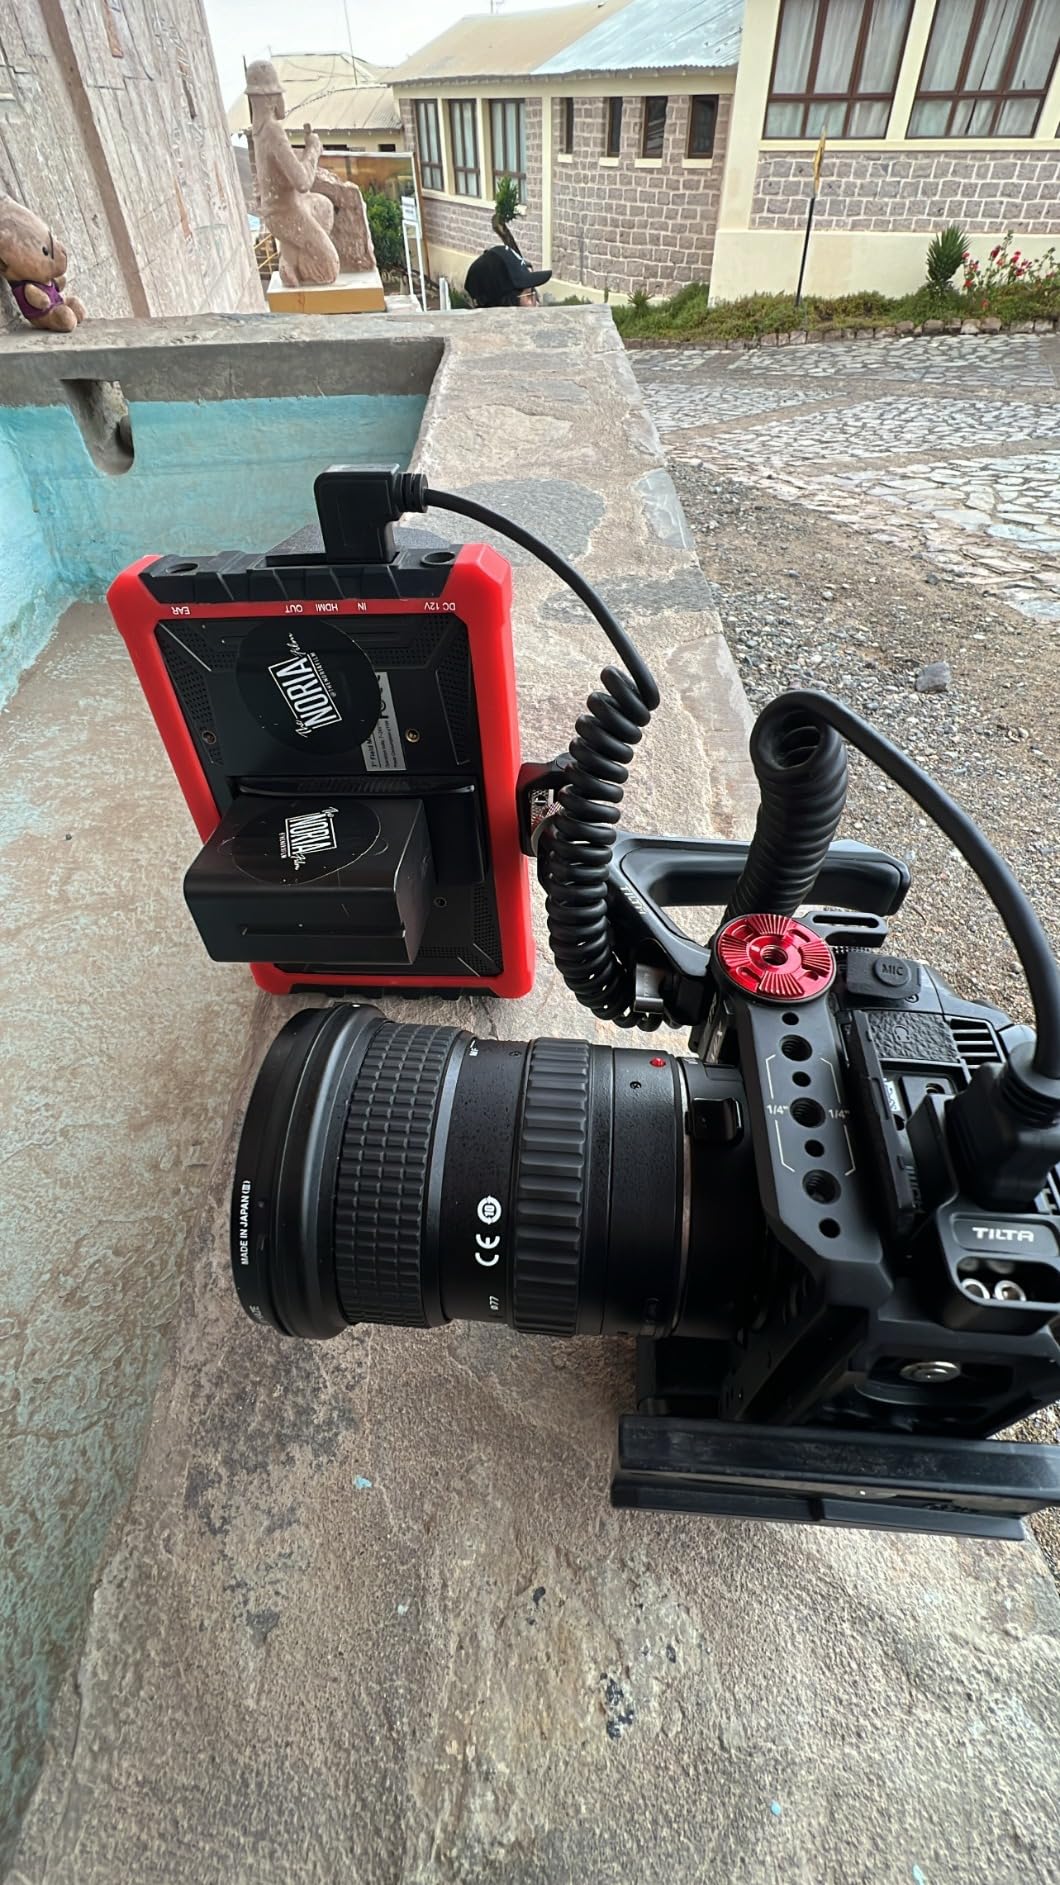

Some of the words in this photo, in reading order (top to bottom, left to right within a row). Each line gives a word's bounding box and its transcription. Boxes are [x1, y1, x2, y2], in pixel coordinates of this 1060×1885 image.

[172, 606, 190, 615] EAR
[285, 604, 303, 613] OUT
[316, 603, 338, 612] HDMI
[358, 603, 367, 612] IN
[425, 602, 440, 612] 12V
[442, 602, 456, 612] DC
[276, 657, 337, 727] NORIA
[289, 813, 332, 855] NORIA
[881, 963, 904, 976] MIC
[240, 1195, 250, 1227] JAPAN
[240, 1228, 248, 1239] IN
[972, 1227, 1034, 1242] TILTA
[240, 1239, 249, 1265] MADE
[475, 1233, 501, 1267] CE
